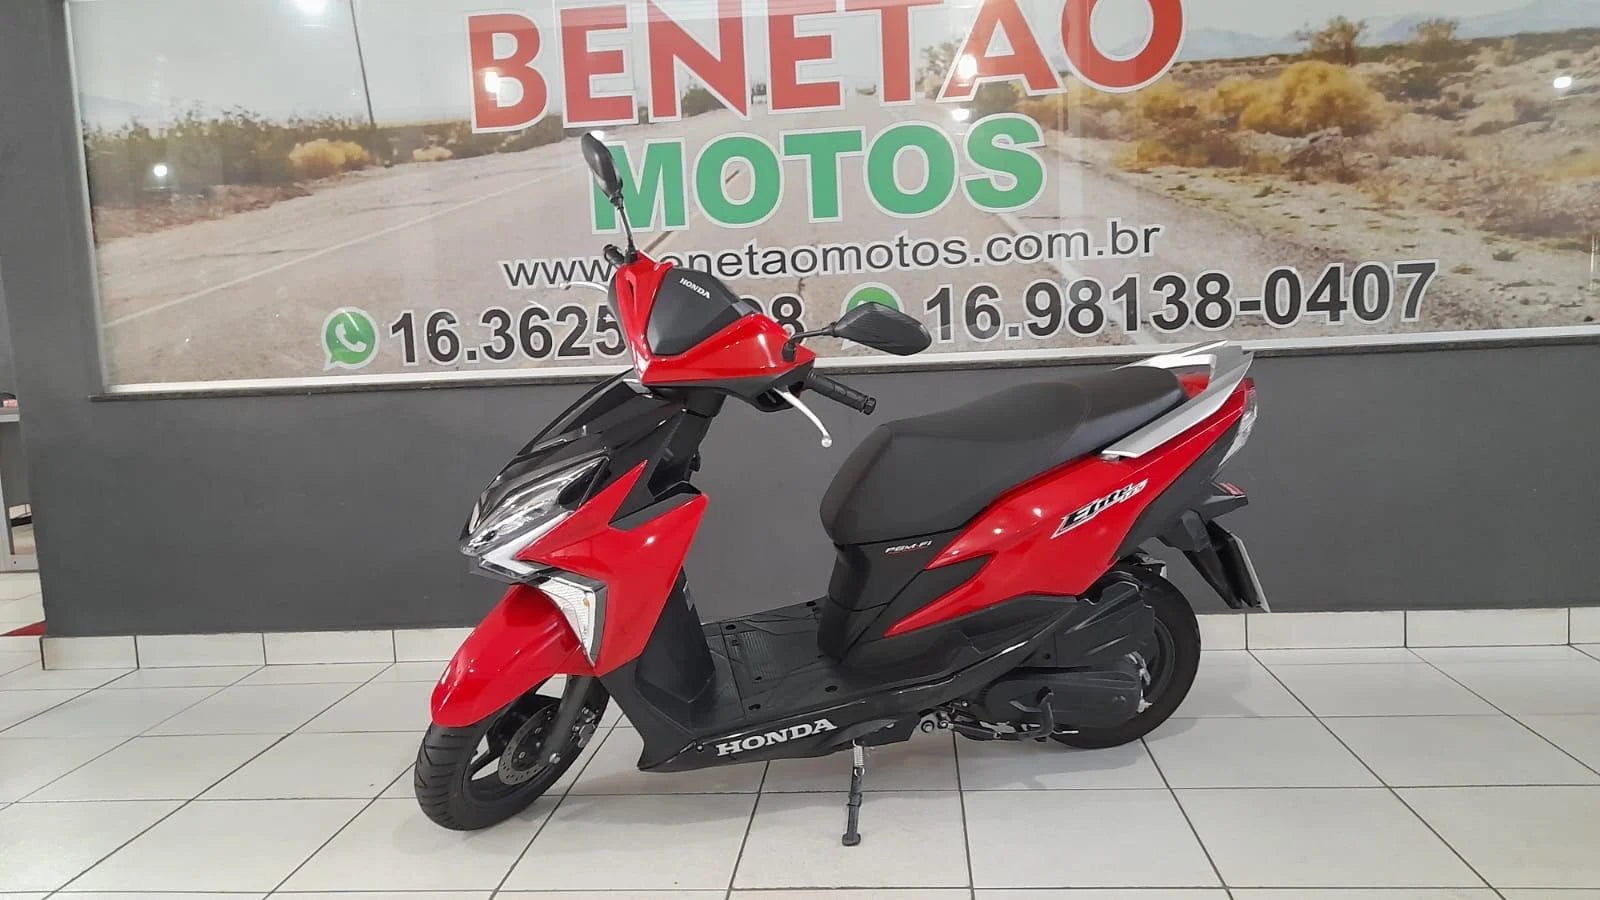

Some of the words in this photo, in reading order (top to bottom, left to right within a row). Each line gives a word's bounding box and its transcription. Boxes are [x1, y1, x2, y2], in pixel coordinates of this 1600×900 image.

[589, 113, 1046, 233] MOTOS
[680, 277, 711, 300] HONDA
[926, 260, 1438, 342] 16.98138-0407
[715, 718, 838, 757] HONDA
